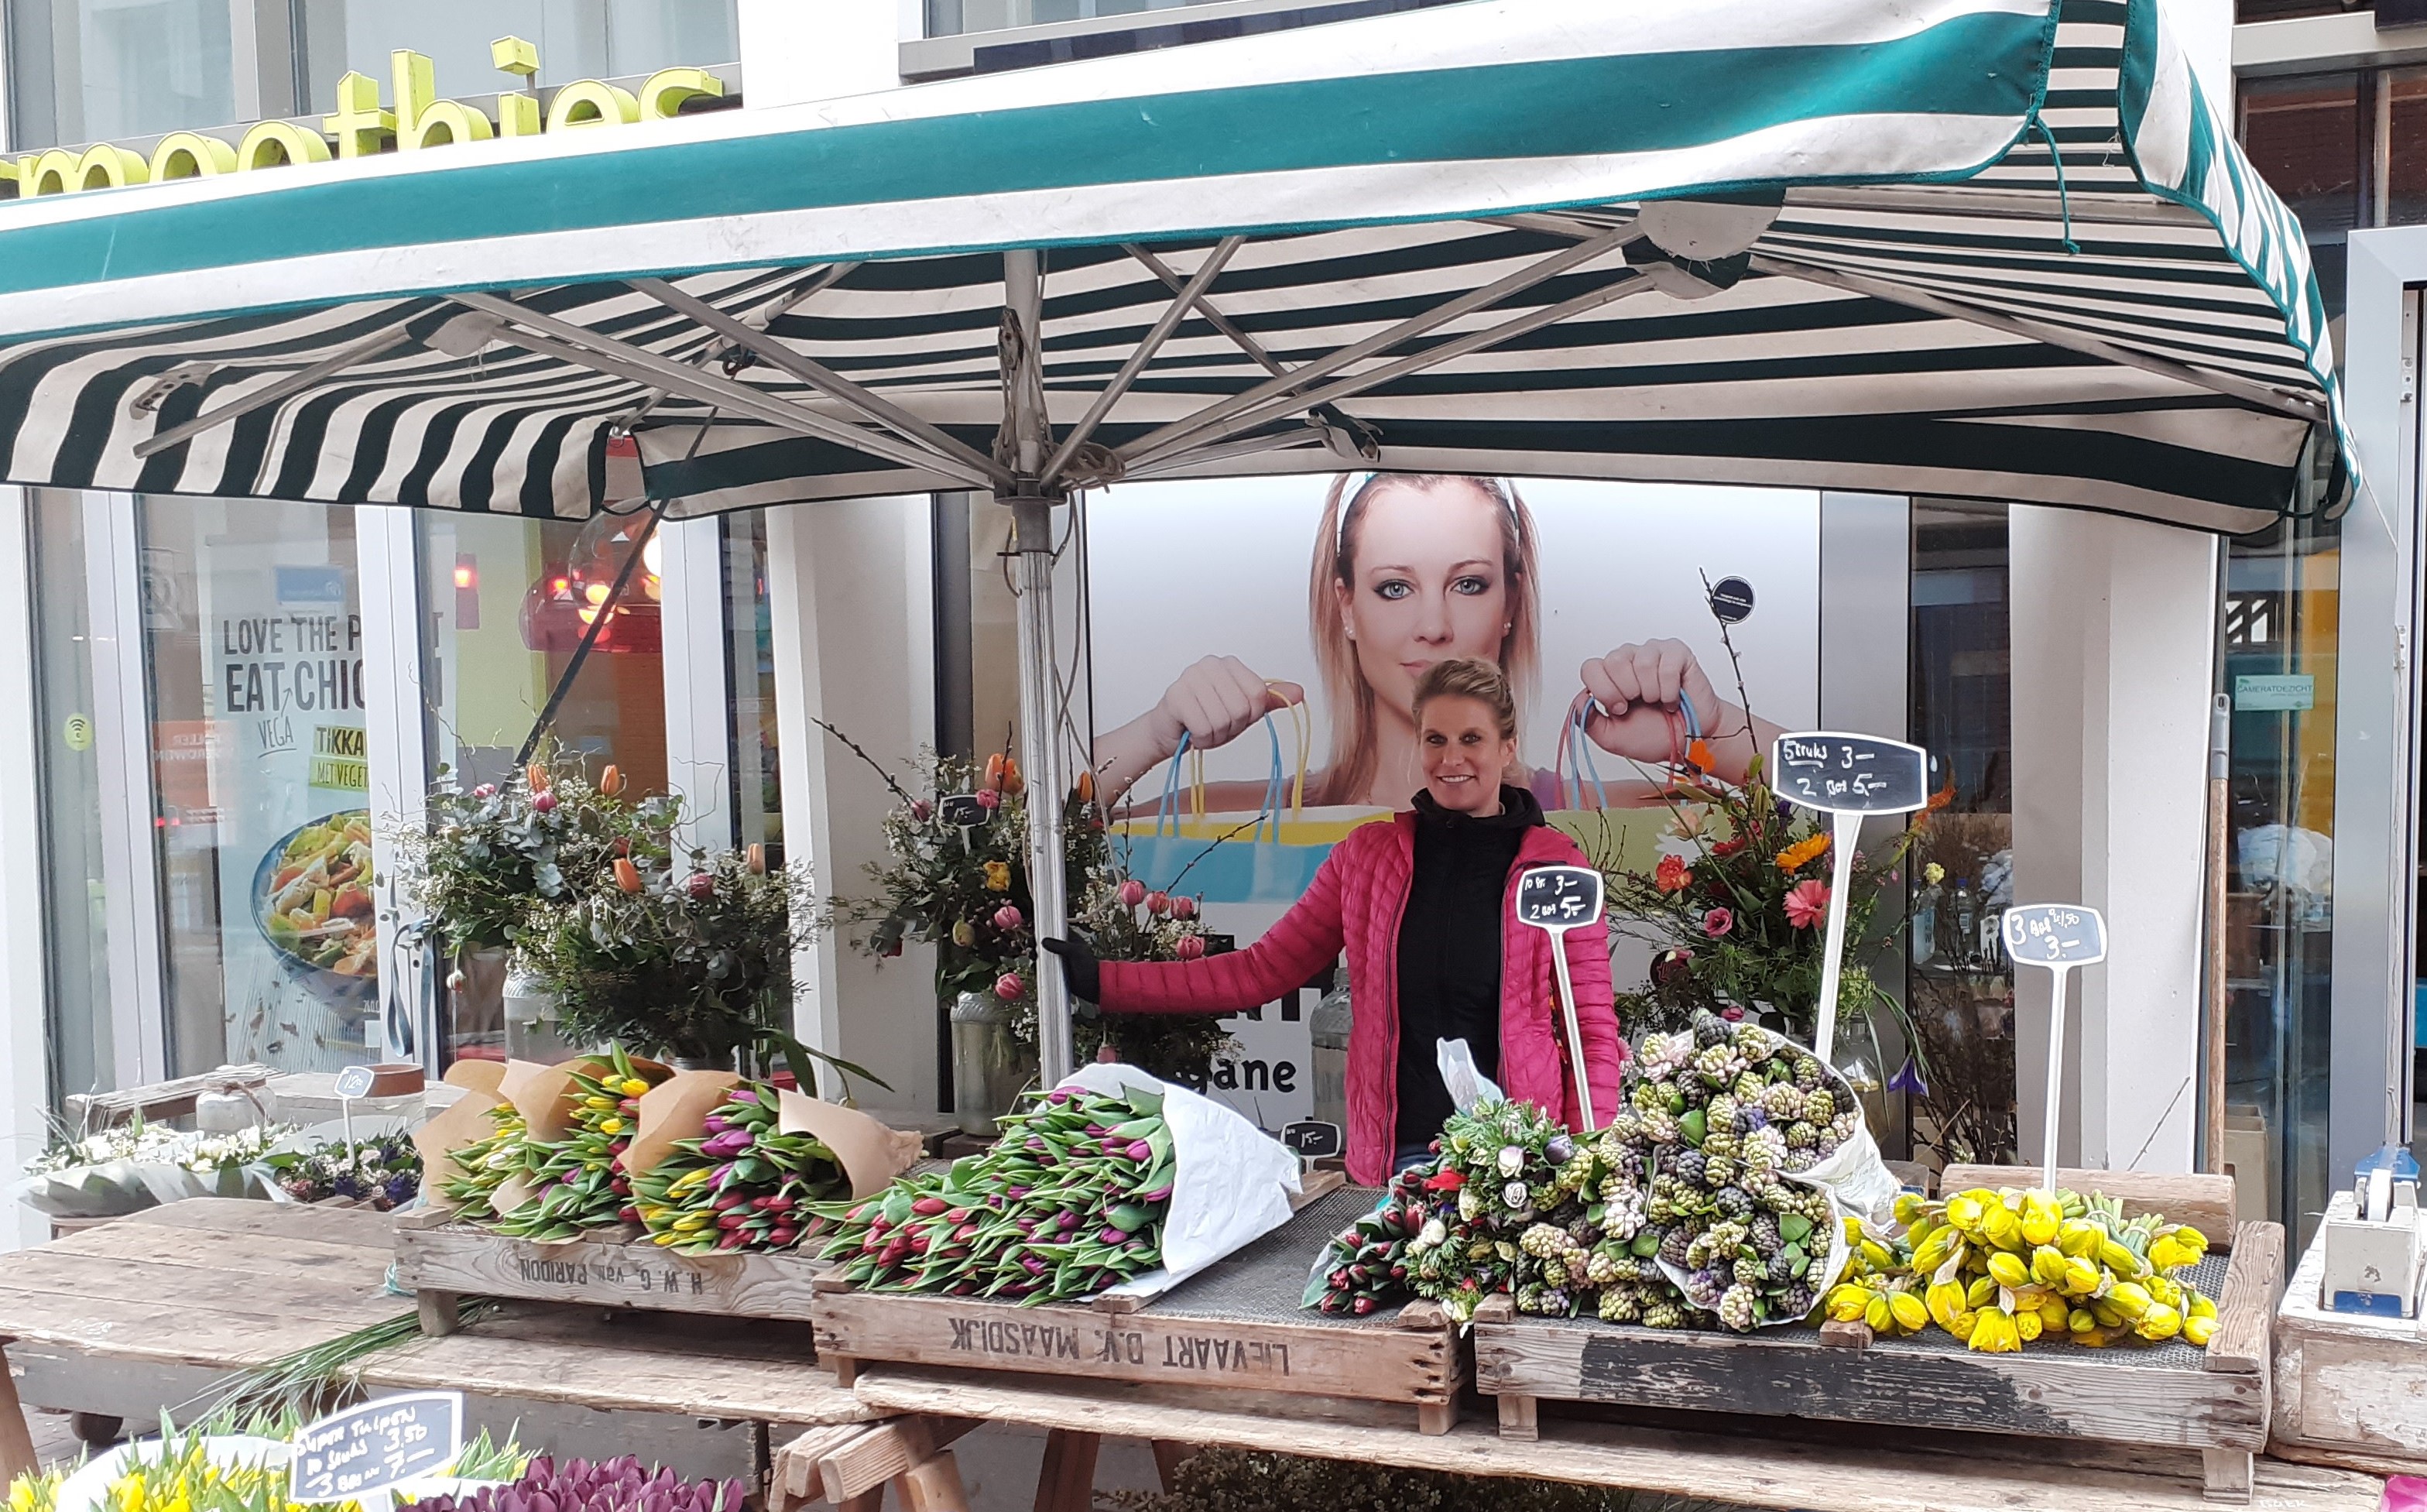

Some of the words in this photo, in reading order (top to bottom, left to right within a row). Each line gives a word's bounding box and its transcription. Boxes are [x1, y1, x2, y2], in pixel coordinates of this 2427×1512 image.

[0, 34, 724, 199] moothies
[224, 619, 283, 655] LOVE
[290, 616, 338, 652] THE
[226, 661, 286, 711] EAT
[258, 716, 294, 749] VEGA
[317, 763, 334, 784] MET
[337, 763, 369, 788] VEGET
[1796, 777, 1817, 797] 2
[1529, 903, 1541, 919] 2
[2011, 914, 2027, 945] 3
[948, 1318, 1080, 1359] MAASDIJK
